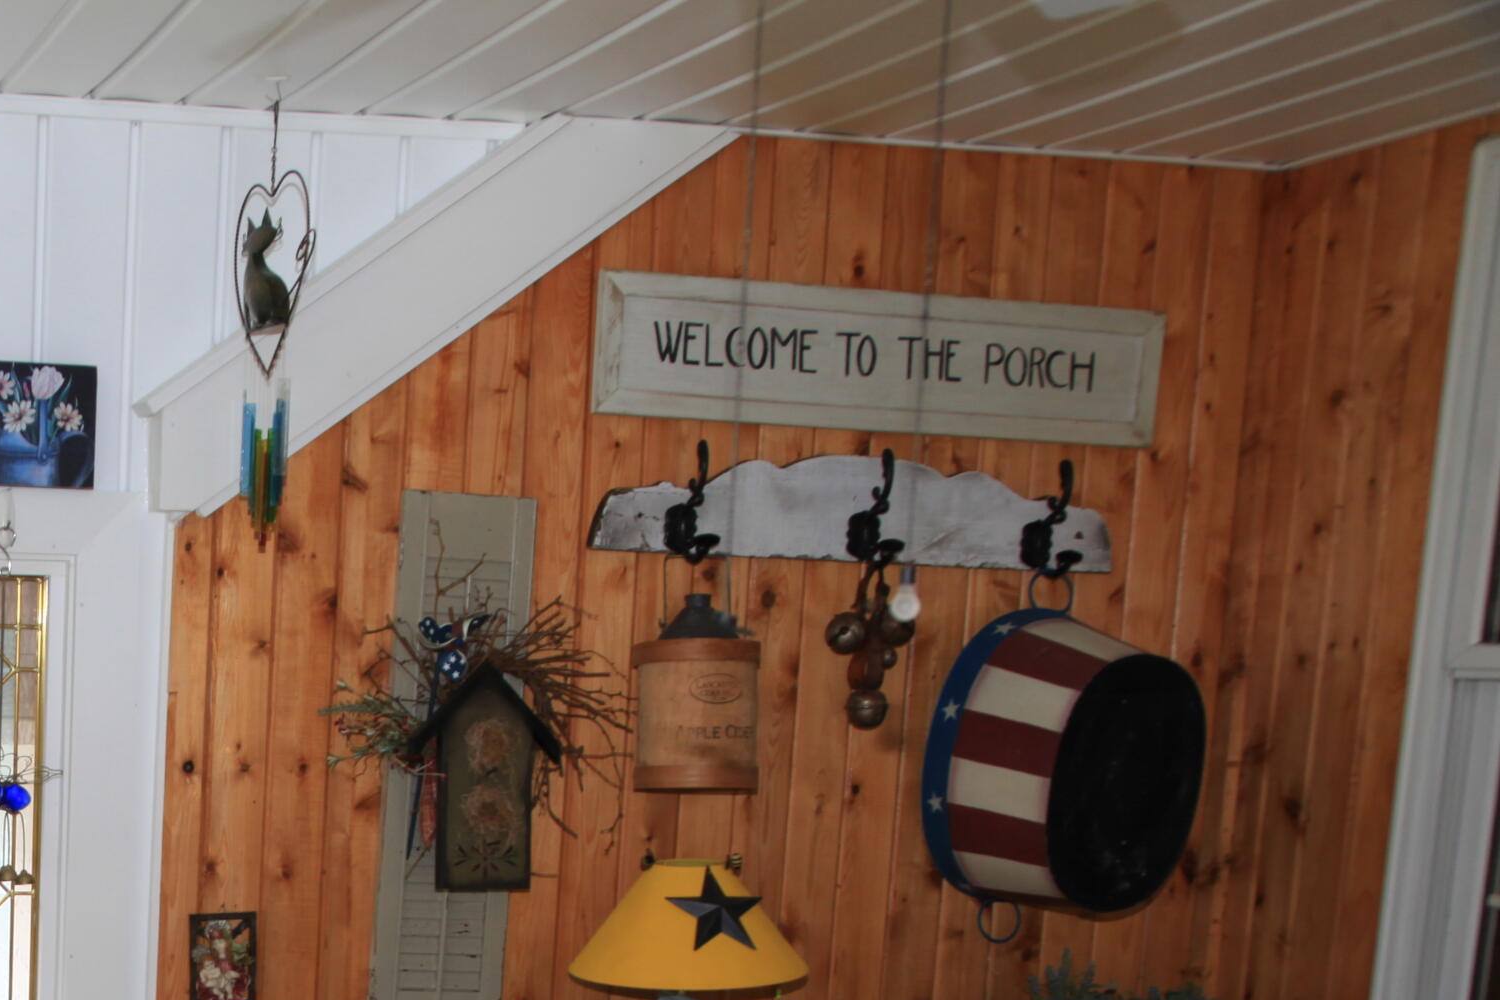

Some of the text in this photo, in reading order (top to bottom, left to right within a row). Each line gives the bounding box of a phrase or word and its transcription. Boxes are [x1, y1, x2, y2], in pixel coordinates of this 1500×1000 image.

[654, 321, 1096, 393] WELCOME TO THE PORCH
